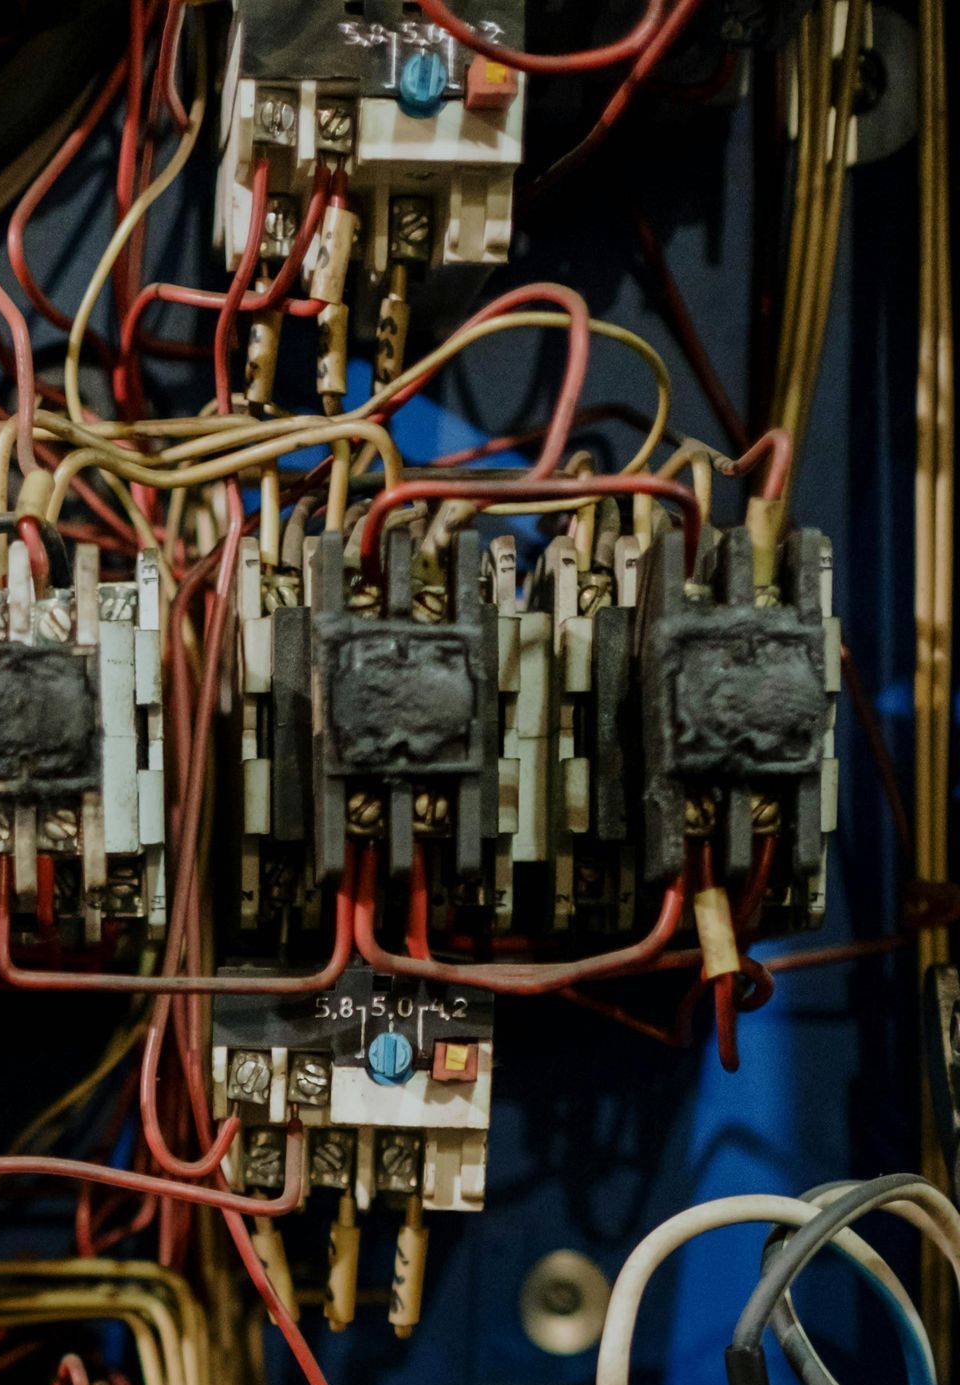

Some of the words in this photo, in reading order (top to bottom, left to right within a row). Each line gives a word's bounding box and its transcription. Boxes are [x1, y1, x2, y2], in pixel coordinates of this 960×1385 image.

[499, 553, 515, 573] 13
[315, 997, 354, 1021] 5,8
[371, 997, 413, 1020] 5,0
[429, 997, 468, 1021] 4,2
